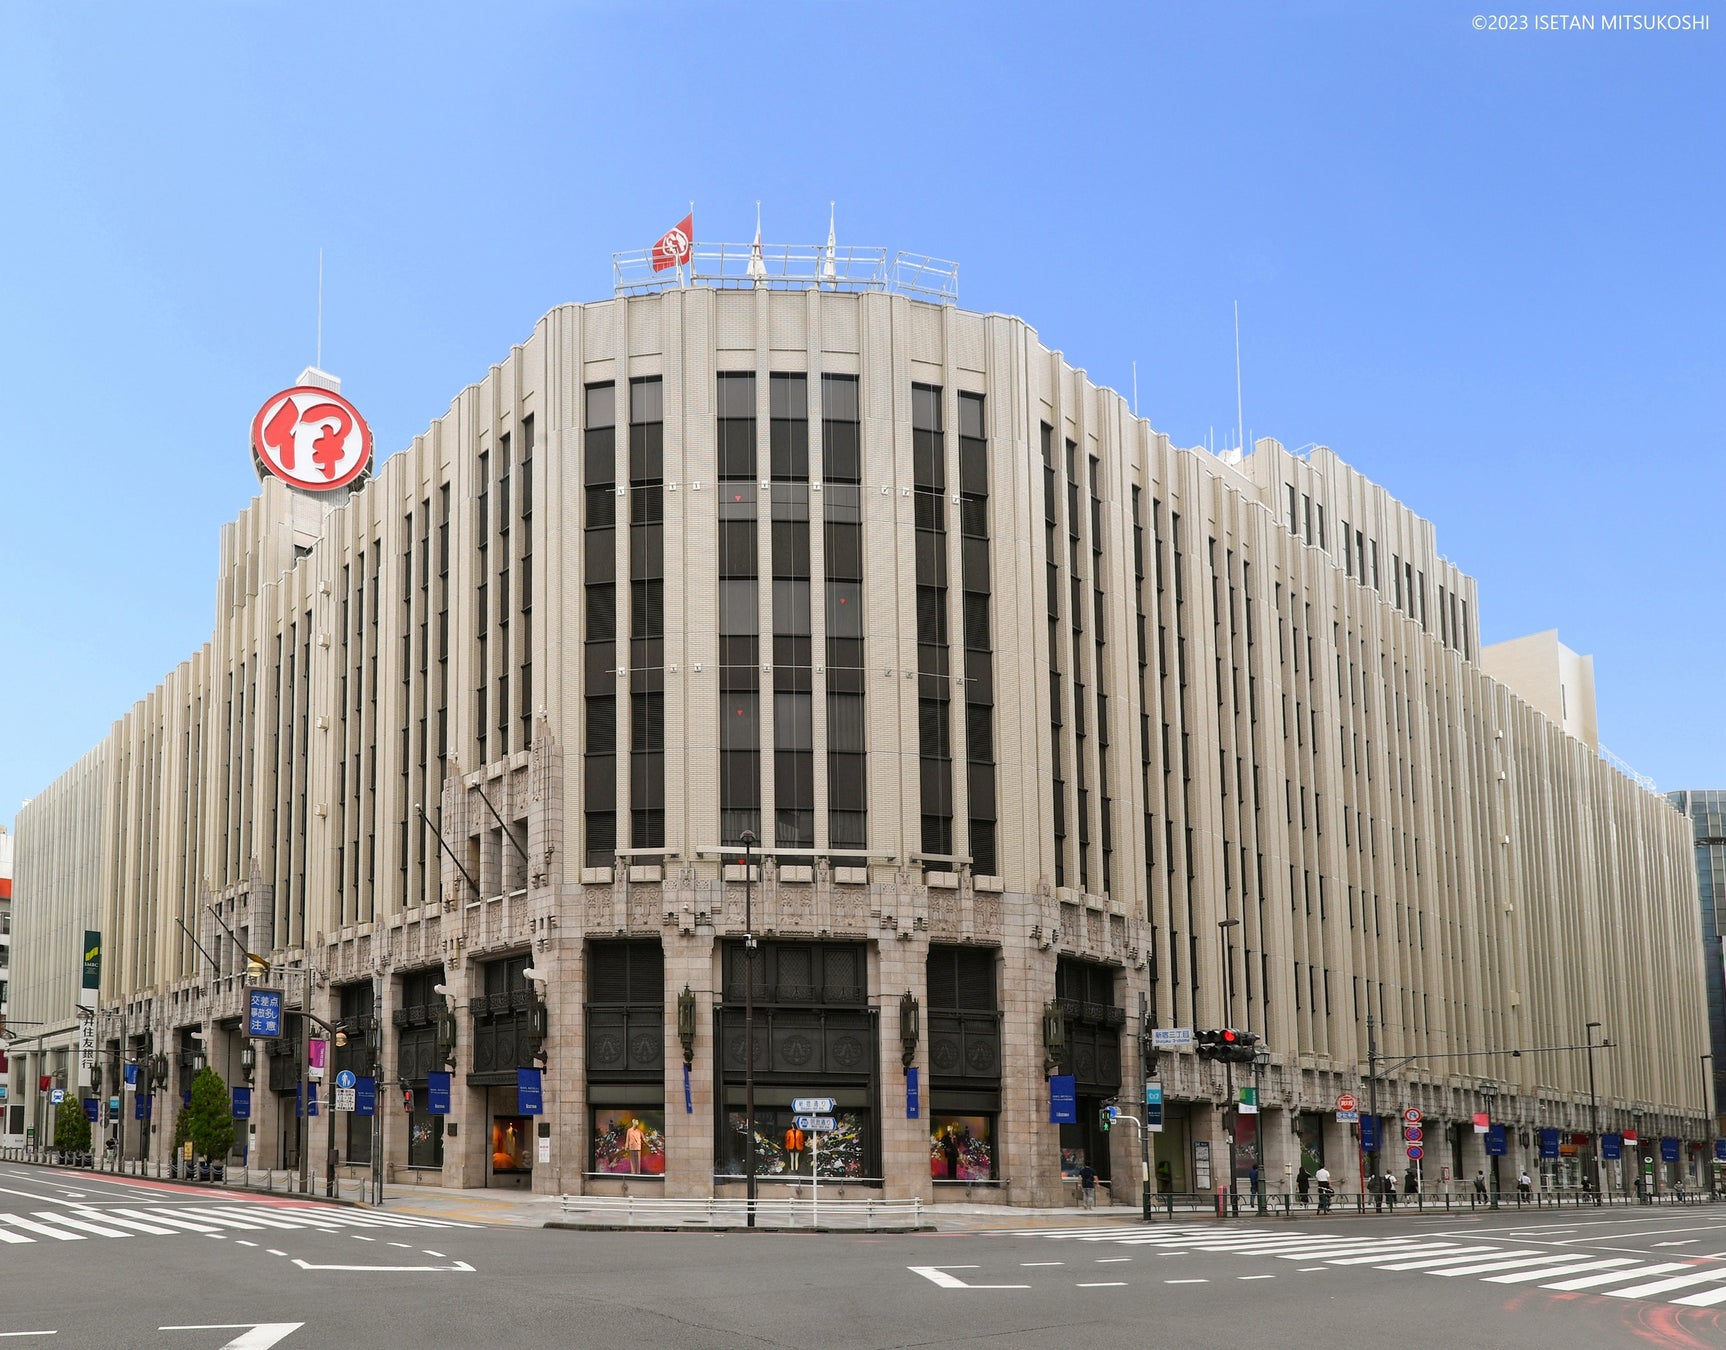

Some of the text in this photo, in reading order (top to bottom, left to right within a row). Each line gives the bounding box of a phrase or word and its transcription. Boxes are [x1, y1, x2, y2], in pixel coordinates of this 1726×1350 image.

[251, 995, 279, 1007] 交差点
[251, 1007, 279, 1019] 事故多し
[251, 1020, 277, 1032] 注意
[1155, 1030, 1190, 1039] 新宿三丁目
